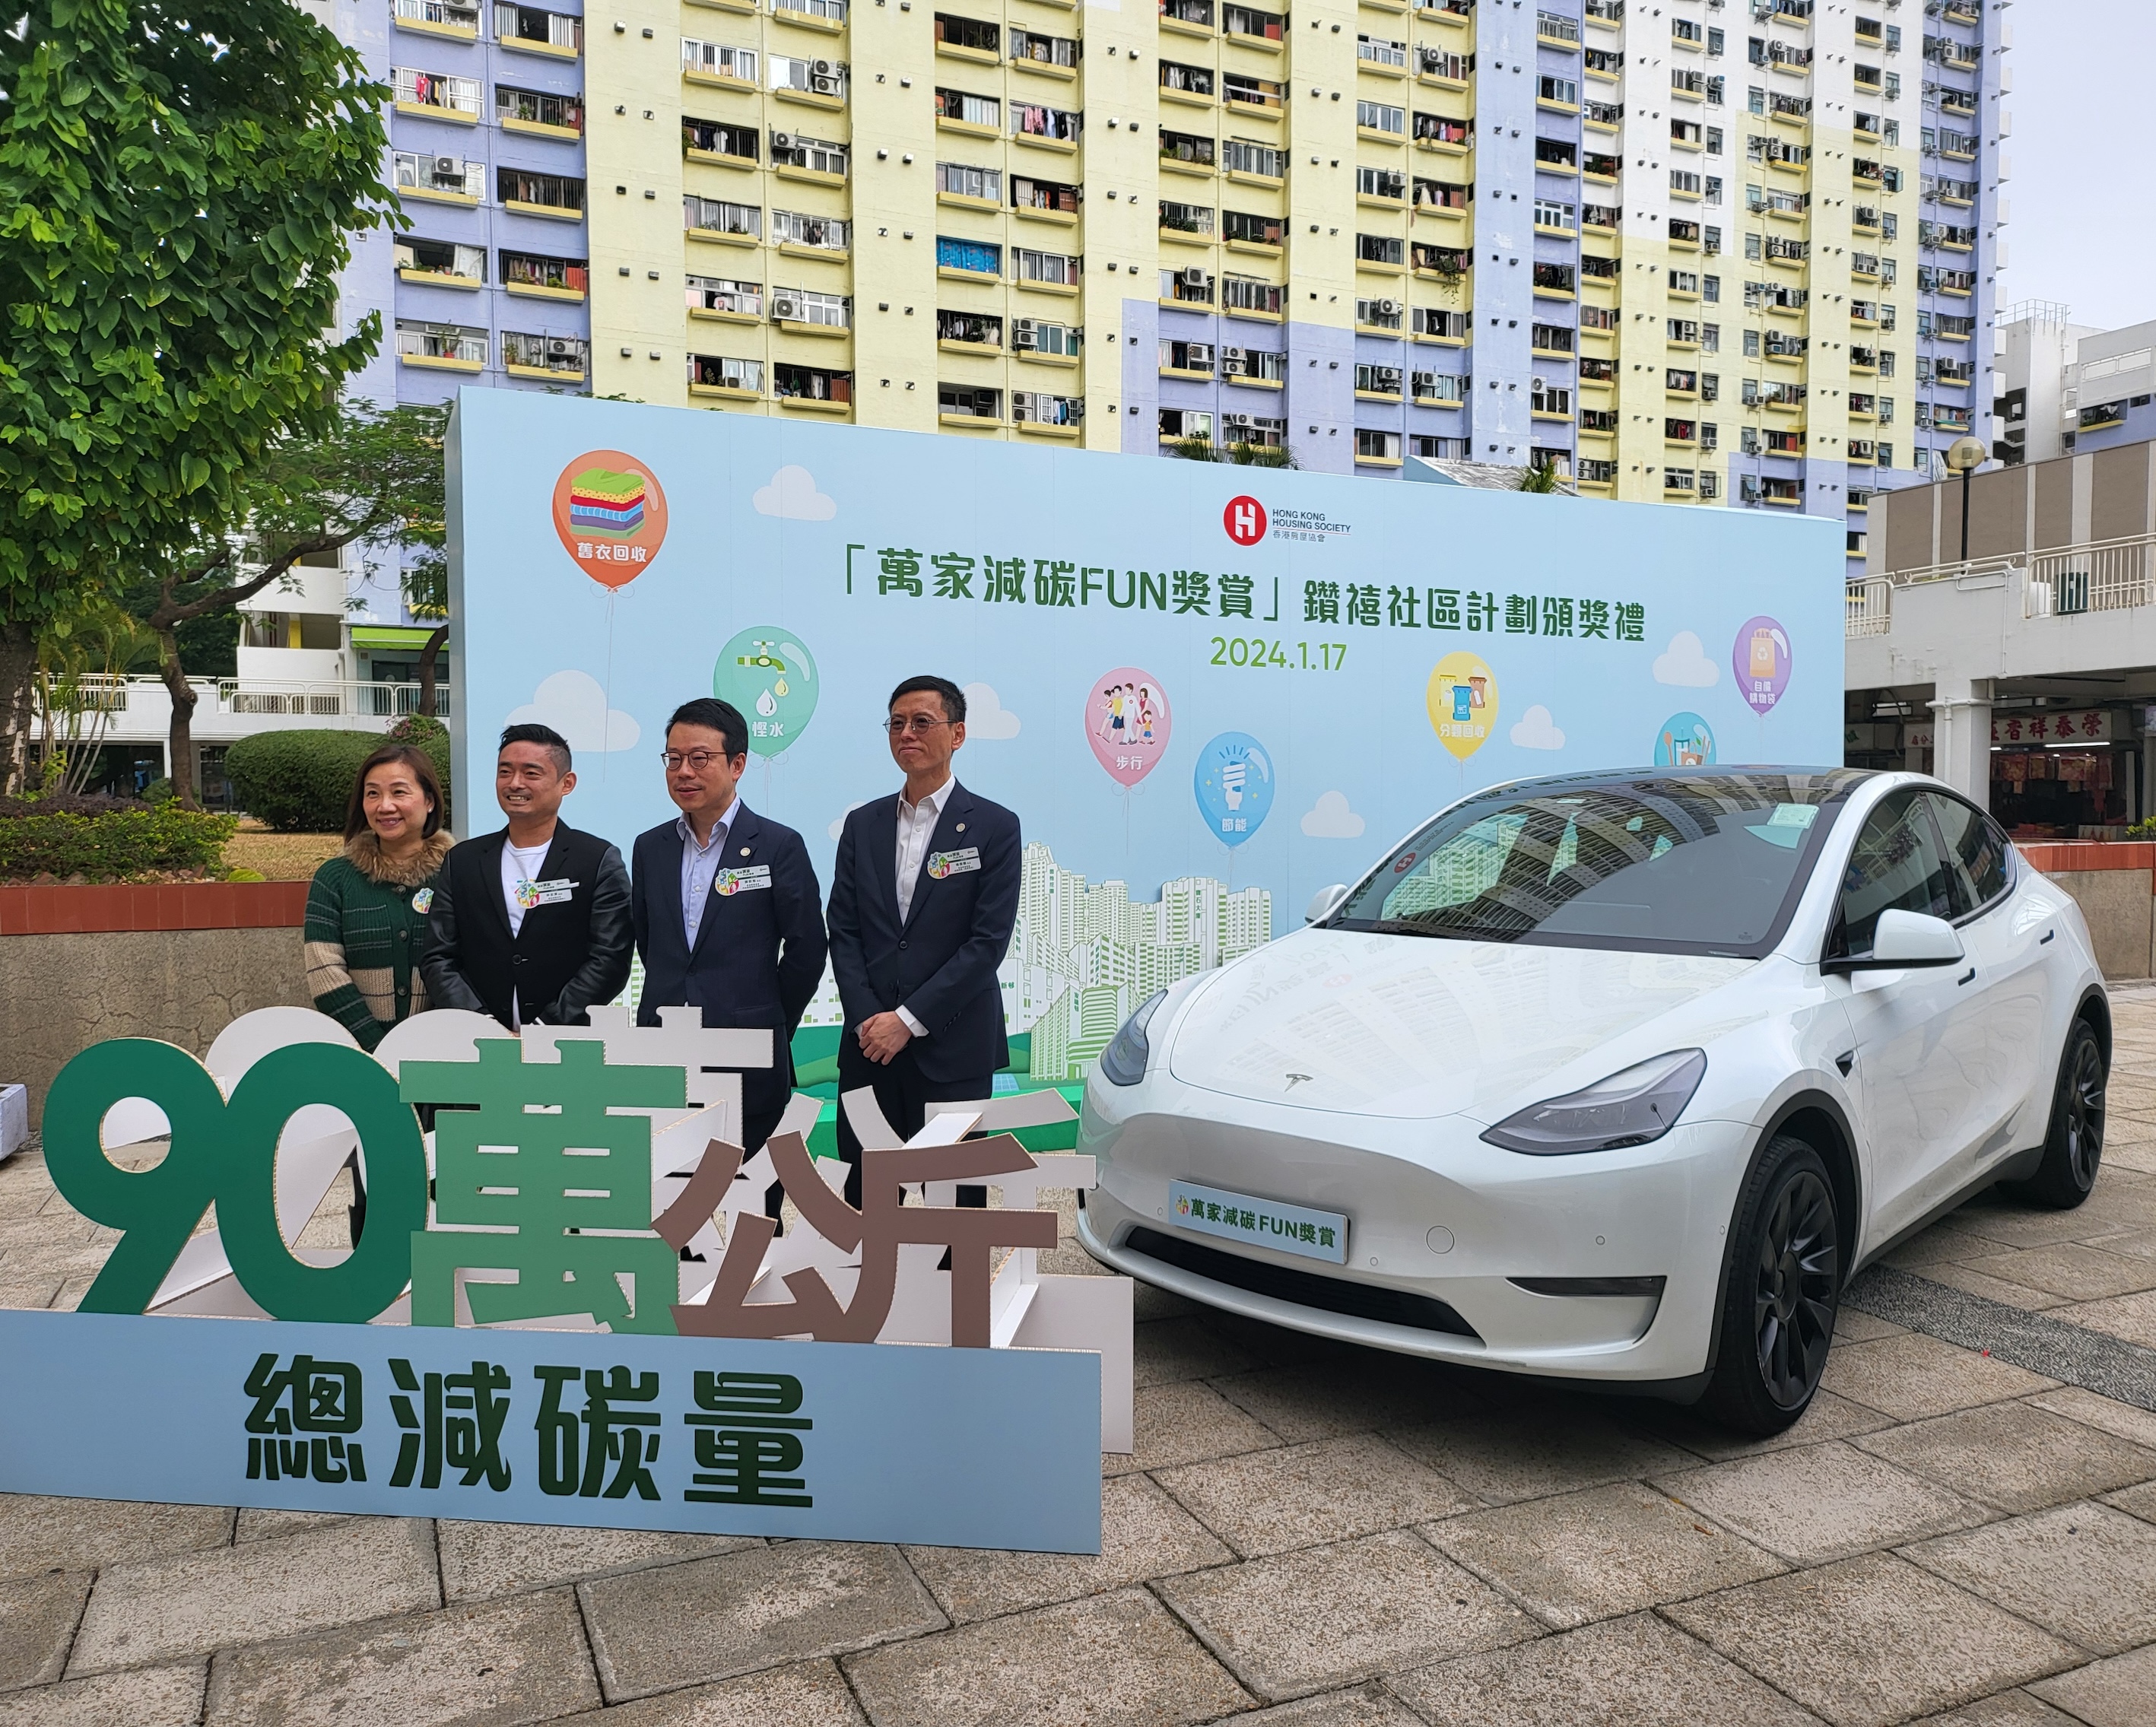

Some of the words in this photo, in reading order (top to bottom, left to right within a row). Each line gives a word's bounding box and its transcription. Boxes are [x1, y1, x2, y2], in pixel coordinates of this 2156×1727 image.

[1272, 509, 1298, 519] HONG
[1300, 511, 1326, 522] KONG
[1272, 518, 1313, 530] HOUSING
[1314, 522, 1351, 533] SOCIETY
[1273, 530, 1326, 543] 香港房屋協會
[576, 541, 647, 563] 舊衣回收
[1210, 637, 1348, 671] 2024.1.17
[751, 721, 785, 738] 慳水
[1115, 755, 1143, 771] 步行
[1221, 817, 1247, 833] 節能
[1190, 1198, 1336, 1249] 萬家減碳FUN獎賞
[243, 1352, 814, 1509] 總減碳量
